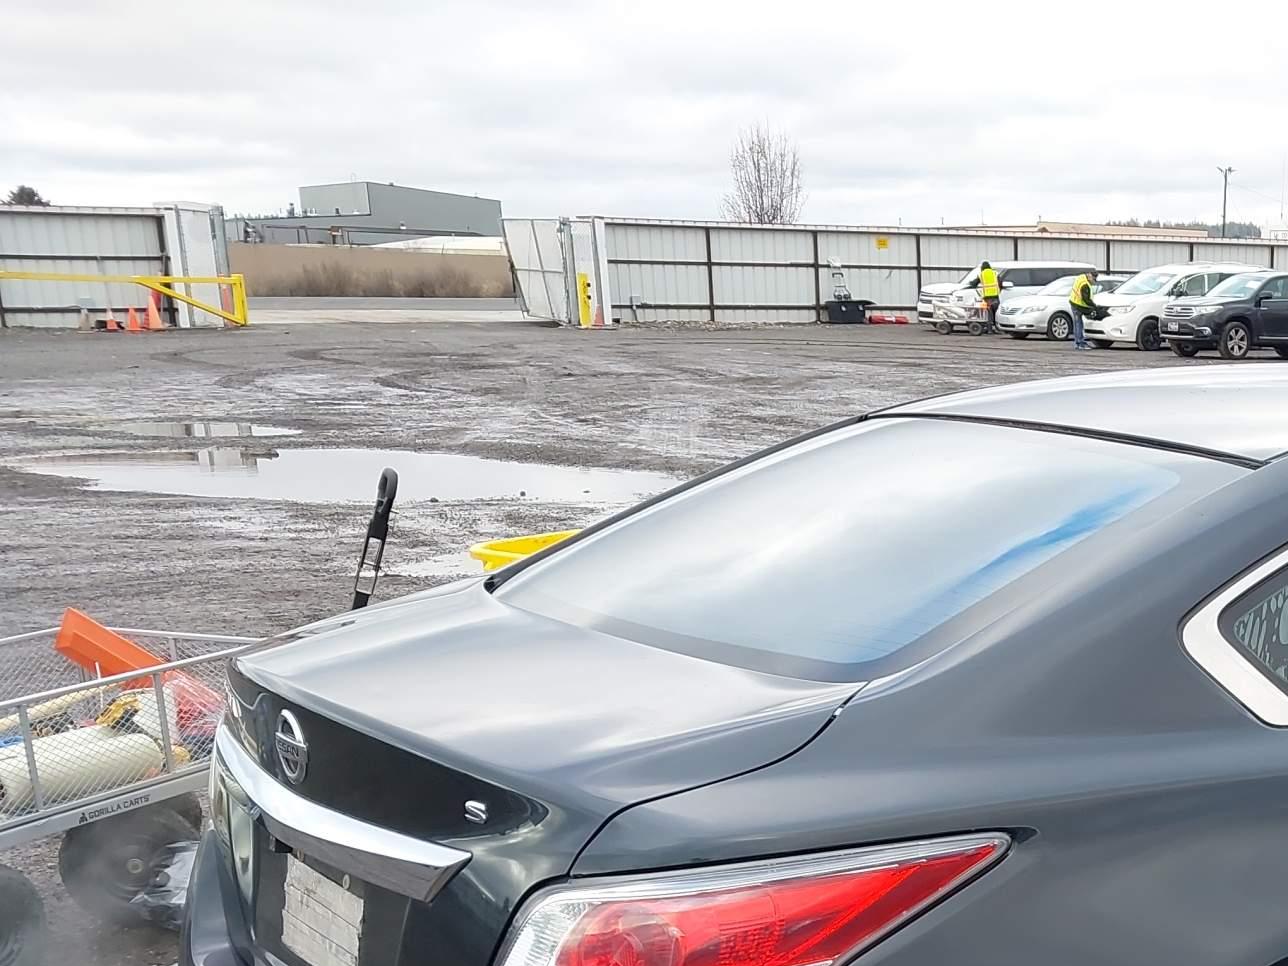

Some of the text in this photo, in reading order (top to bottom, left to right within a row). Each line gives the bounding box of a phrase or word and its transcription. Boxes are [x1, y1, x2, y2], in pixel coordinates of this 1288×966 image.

[88, 794, 150, 819] GORILLA CARTS
[464, 800, 487, 824] S
